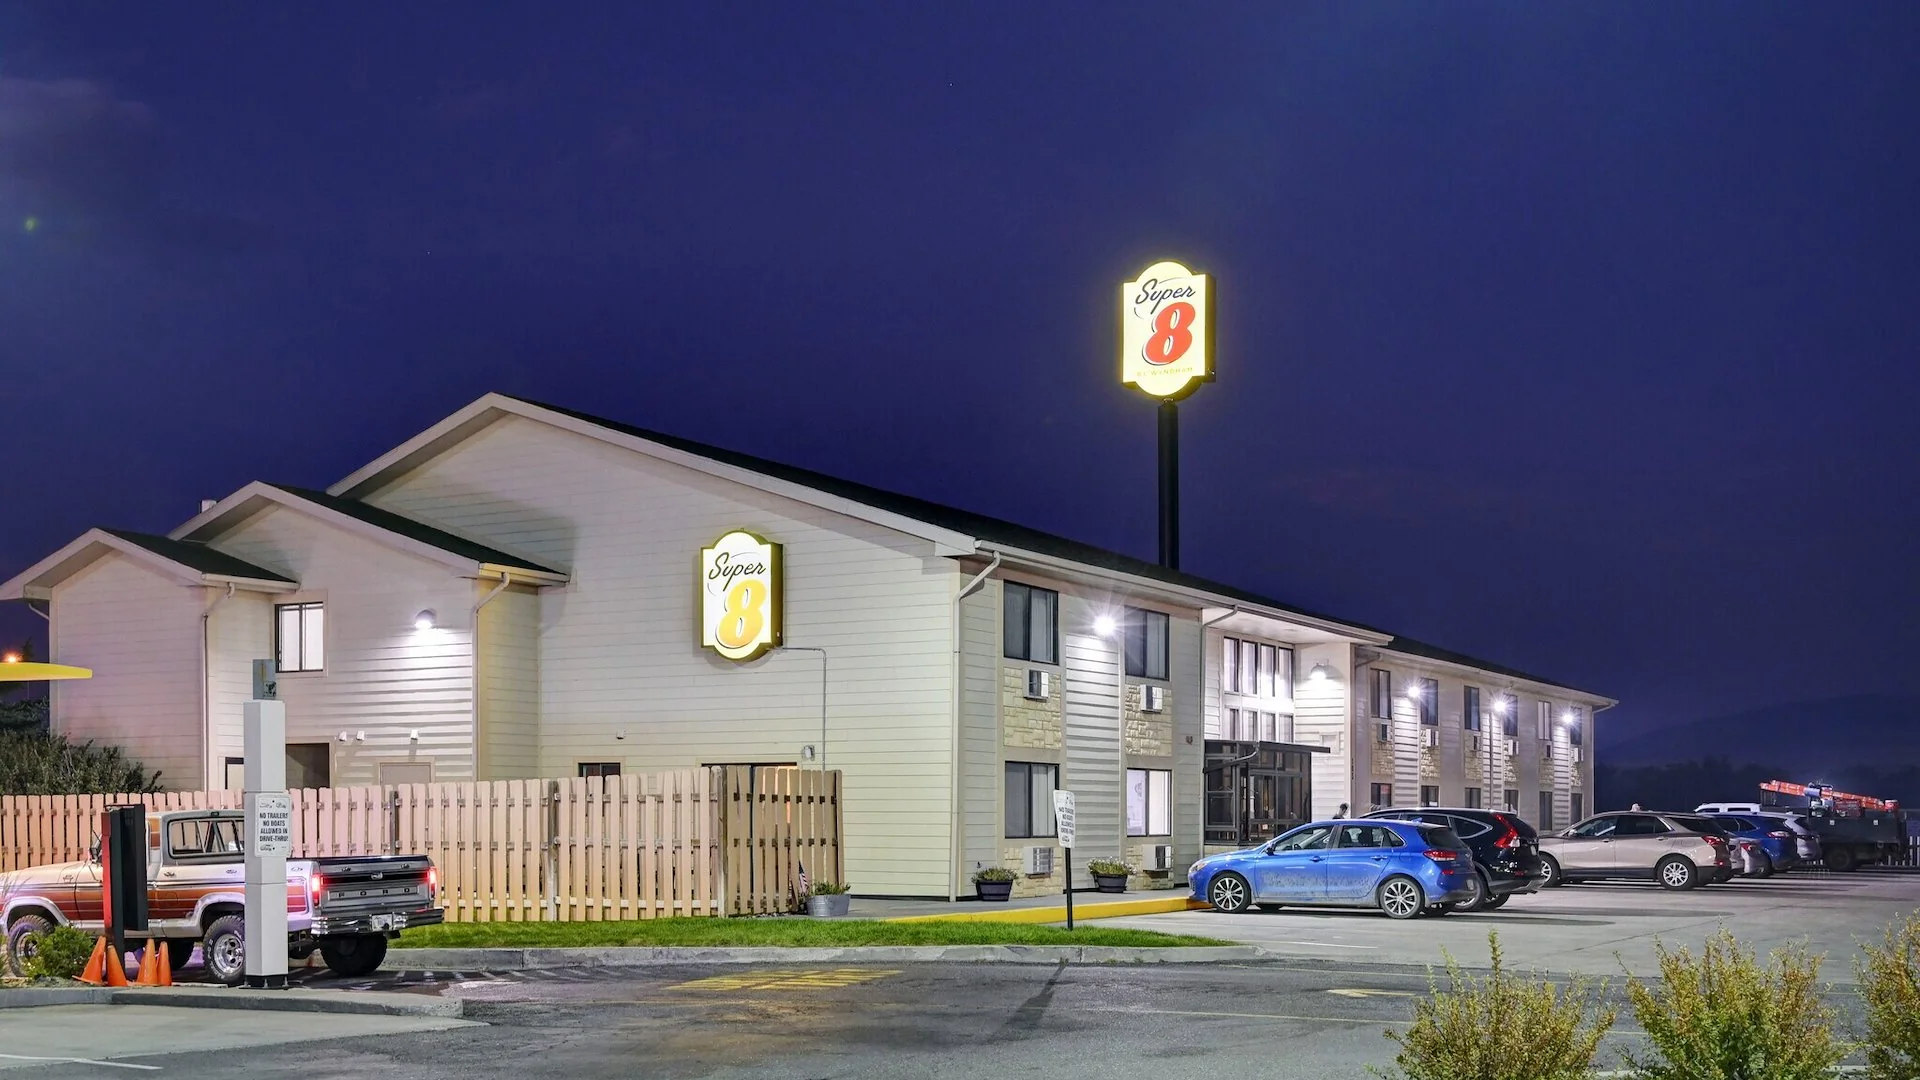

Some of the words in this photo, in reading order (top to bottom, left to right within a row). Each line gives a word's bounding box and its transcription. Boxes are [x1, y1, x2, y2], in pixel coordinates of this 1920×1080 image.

[1135, 278, 1196, 315] Super
[1143, 302, 1196, 365] 8
[708, 551, 767, 592] Super
[717, 579, 767, 648] 8
[338, 887, 411, 898] FORD
